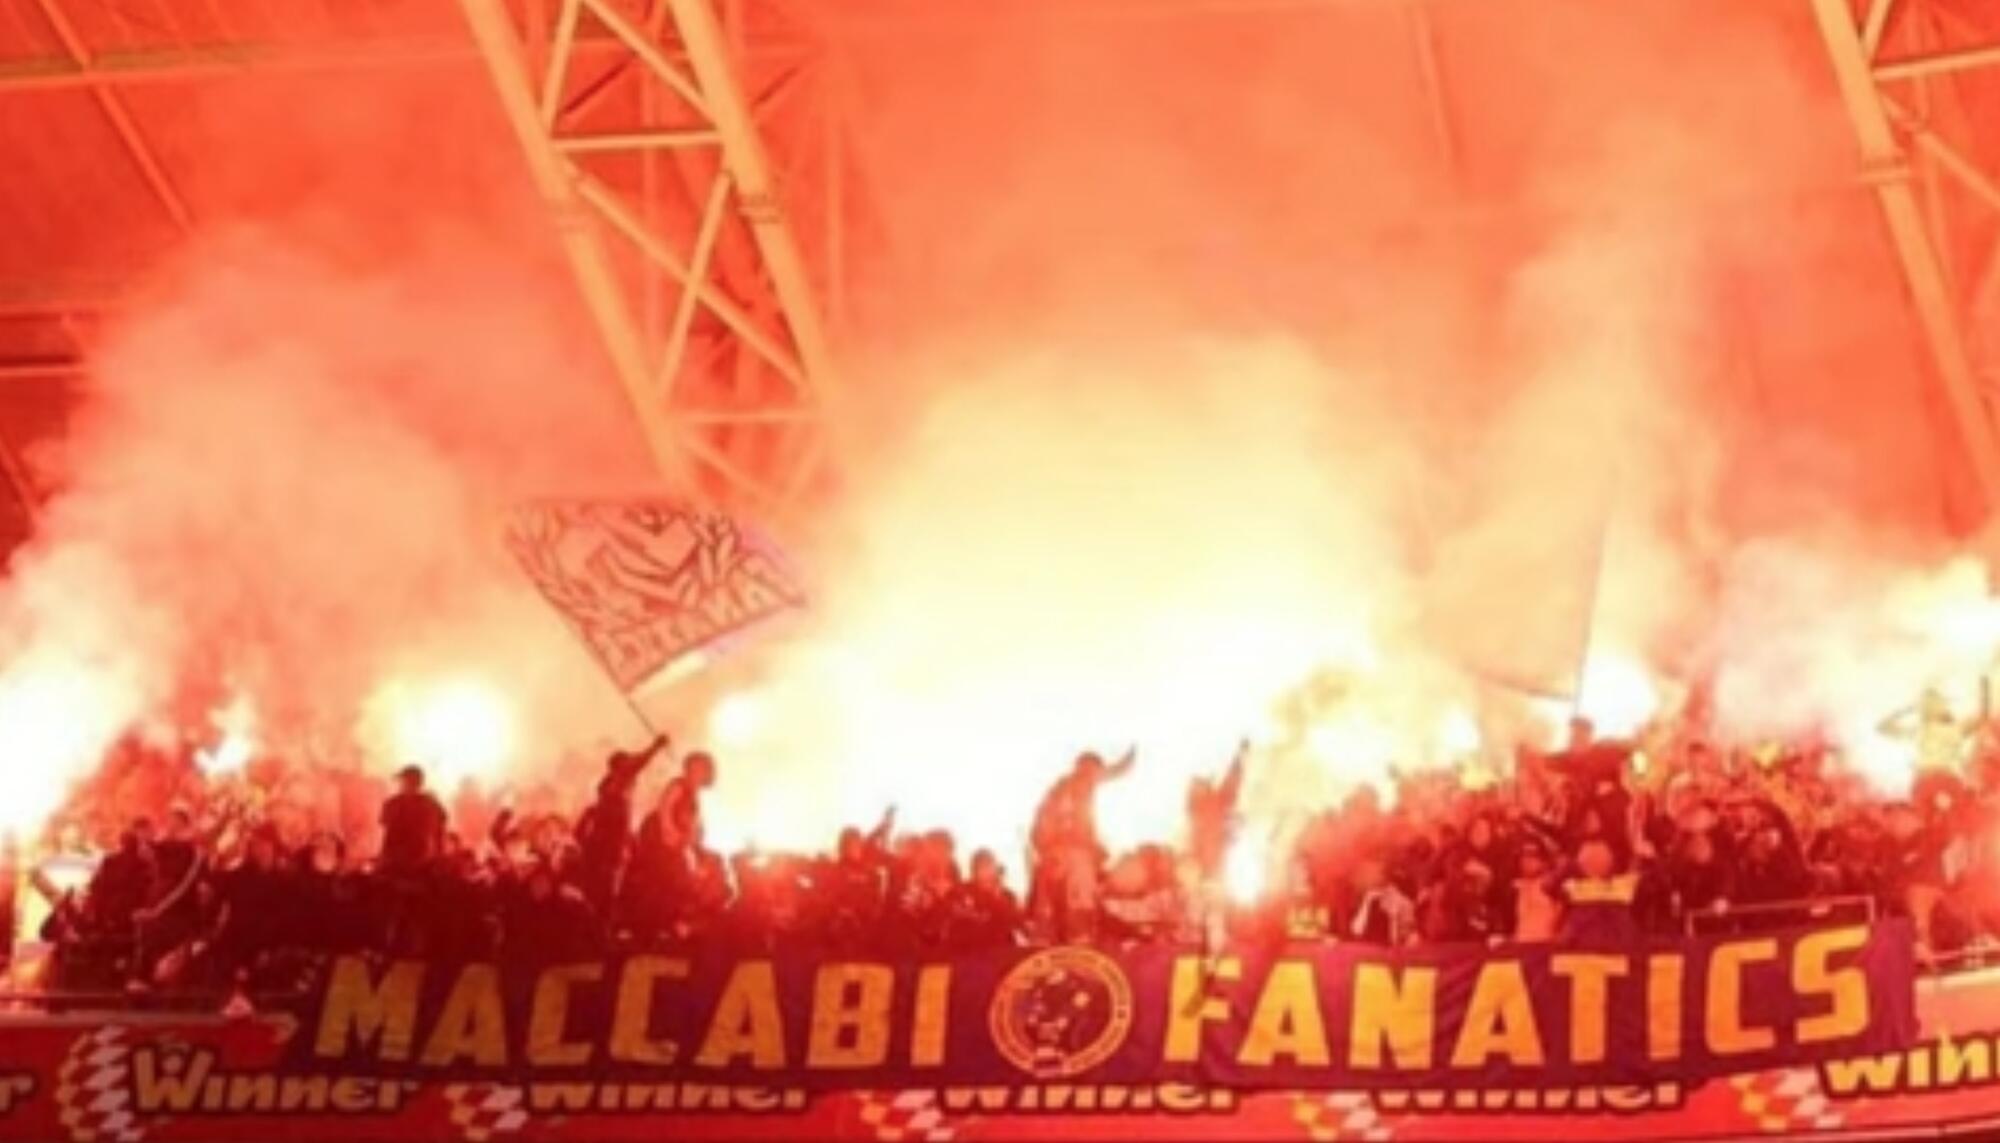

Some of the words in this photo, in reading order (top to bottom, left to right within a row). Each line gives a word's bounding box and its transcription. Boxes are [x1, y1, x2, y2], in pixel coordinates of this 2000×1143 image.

[314, 954, 951, 1068] MACCABI
[1163, 924, 1871, 1068] FANATICS
[133, 1049, 419, 1111] Winner
